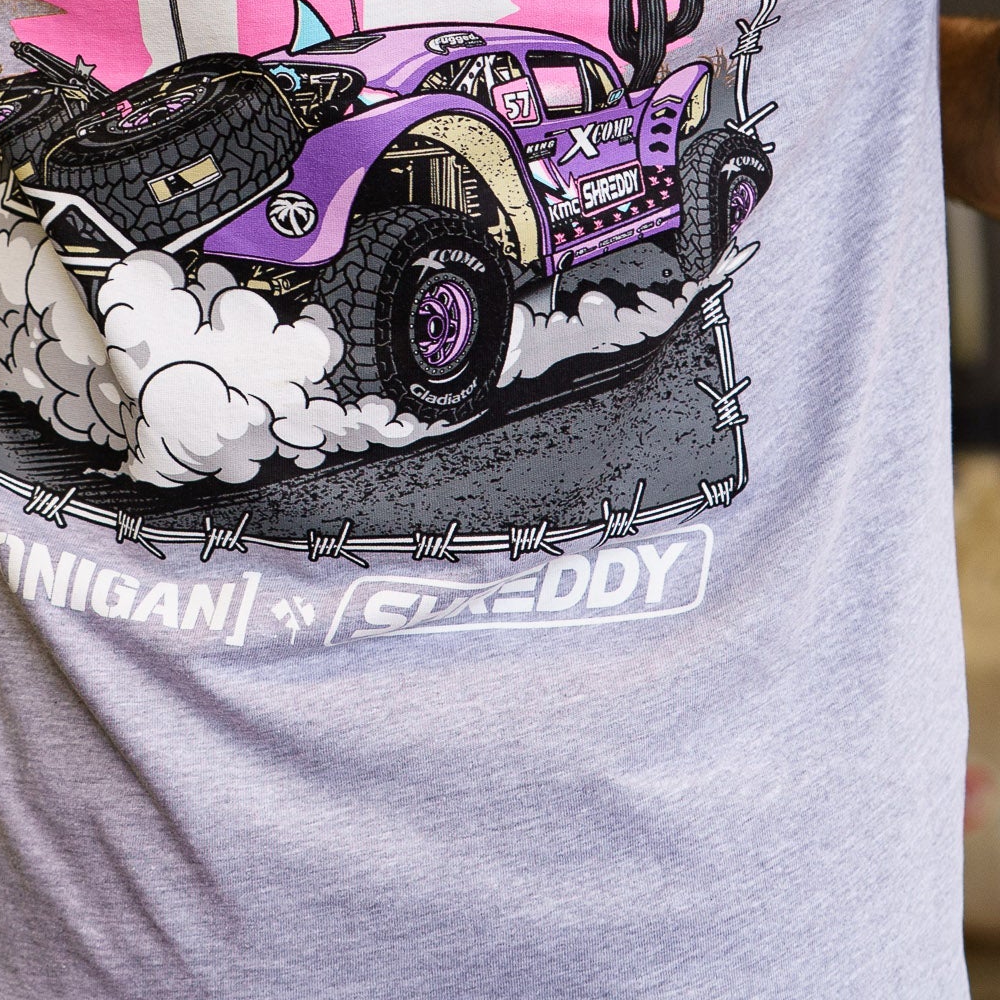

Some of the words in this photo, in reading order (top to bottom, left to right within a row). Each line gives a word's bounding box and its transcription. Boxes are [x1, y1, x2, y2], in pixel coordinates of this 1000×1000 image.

[502, 90, 530, 119] 57
[525, 140, 556, 155] KING
[582, 167, 639, 210] SHREDDY
[409, 375, 478, 406] Gladiator
